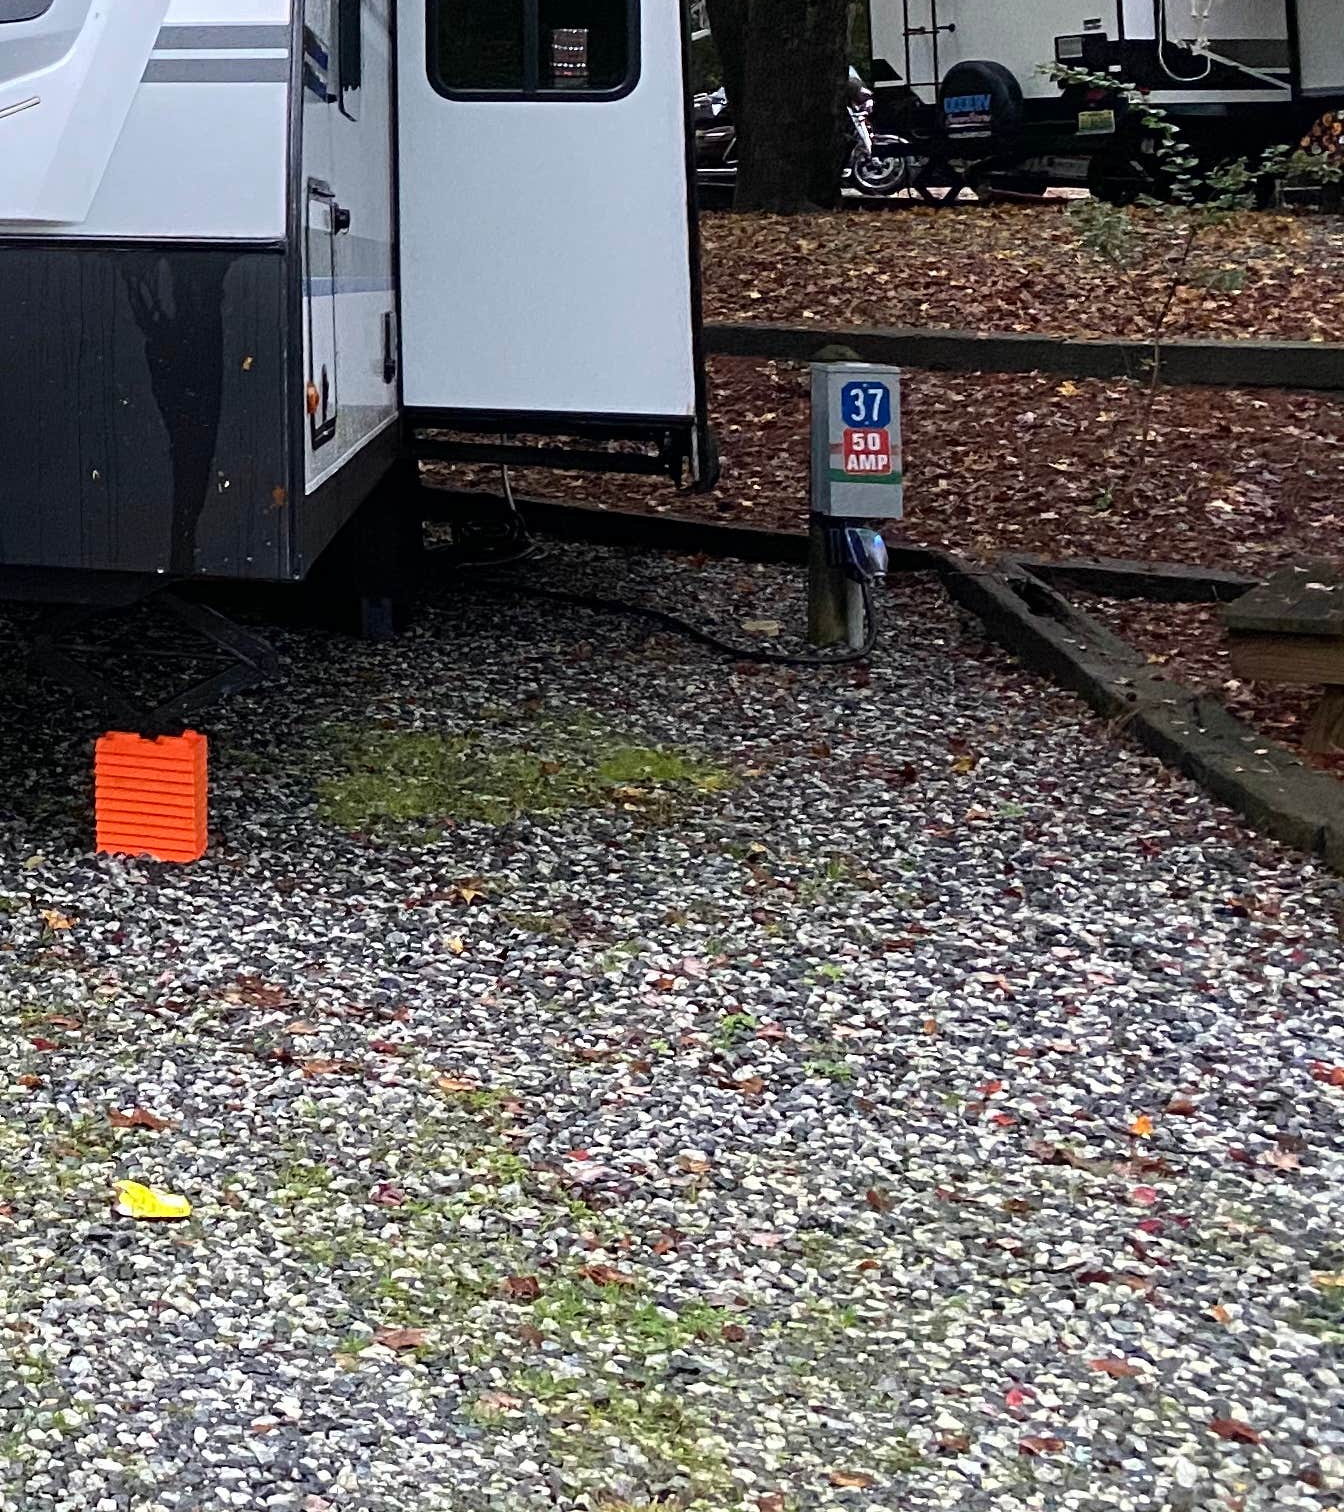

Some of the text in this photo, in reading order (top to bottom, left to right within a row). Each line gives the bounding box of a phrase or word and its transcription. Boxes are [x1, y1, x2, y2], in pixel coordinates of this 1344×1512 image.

[850, 388, 884, 422] 37
[852, 432, 881, 451] 50
[846, 454, 888, 471] AMP
